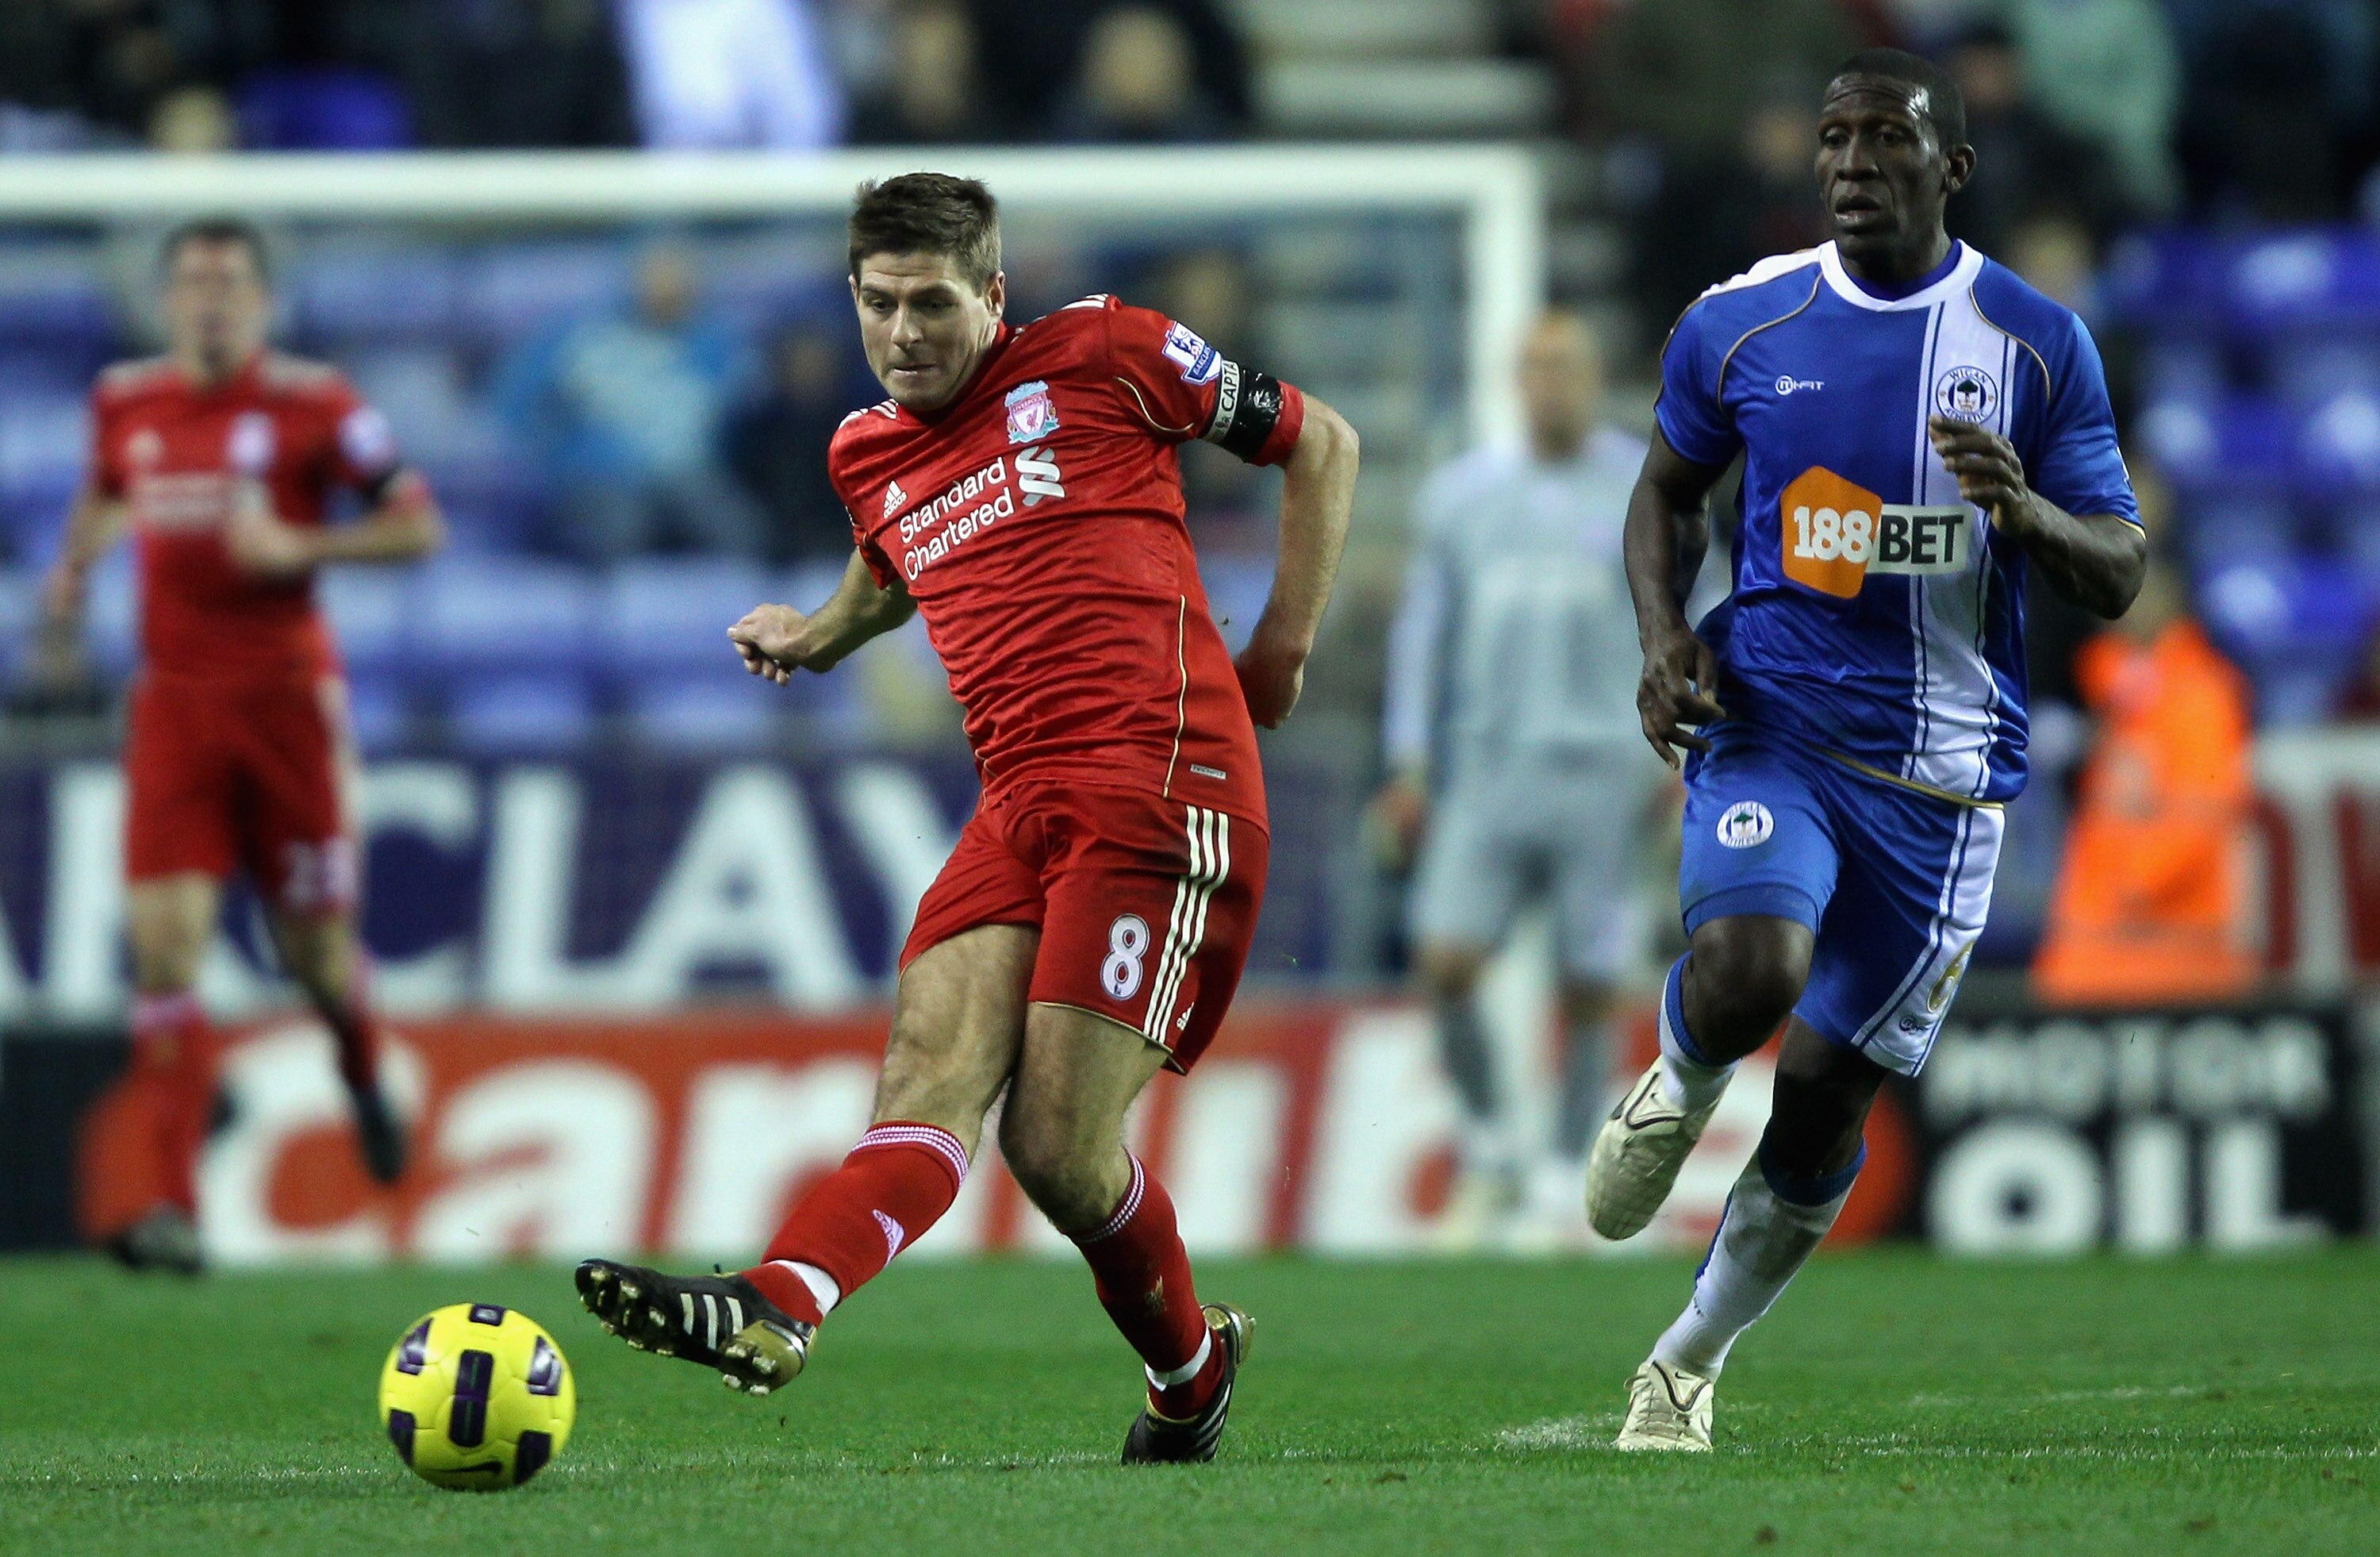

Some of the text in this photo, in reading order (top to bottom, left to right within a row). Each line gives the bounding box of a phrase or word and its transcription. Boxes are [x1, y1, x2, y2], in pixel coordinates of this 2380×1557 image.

[900, 456, 1006, 544] Standard
[904, 486, 1014, 581] Chartered
[1793, 505, 1964, 563] 188BET
[1100, 913, 1150, 1001] 8
[1926, 1117, 2337, 1258] OIL
